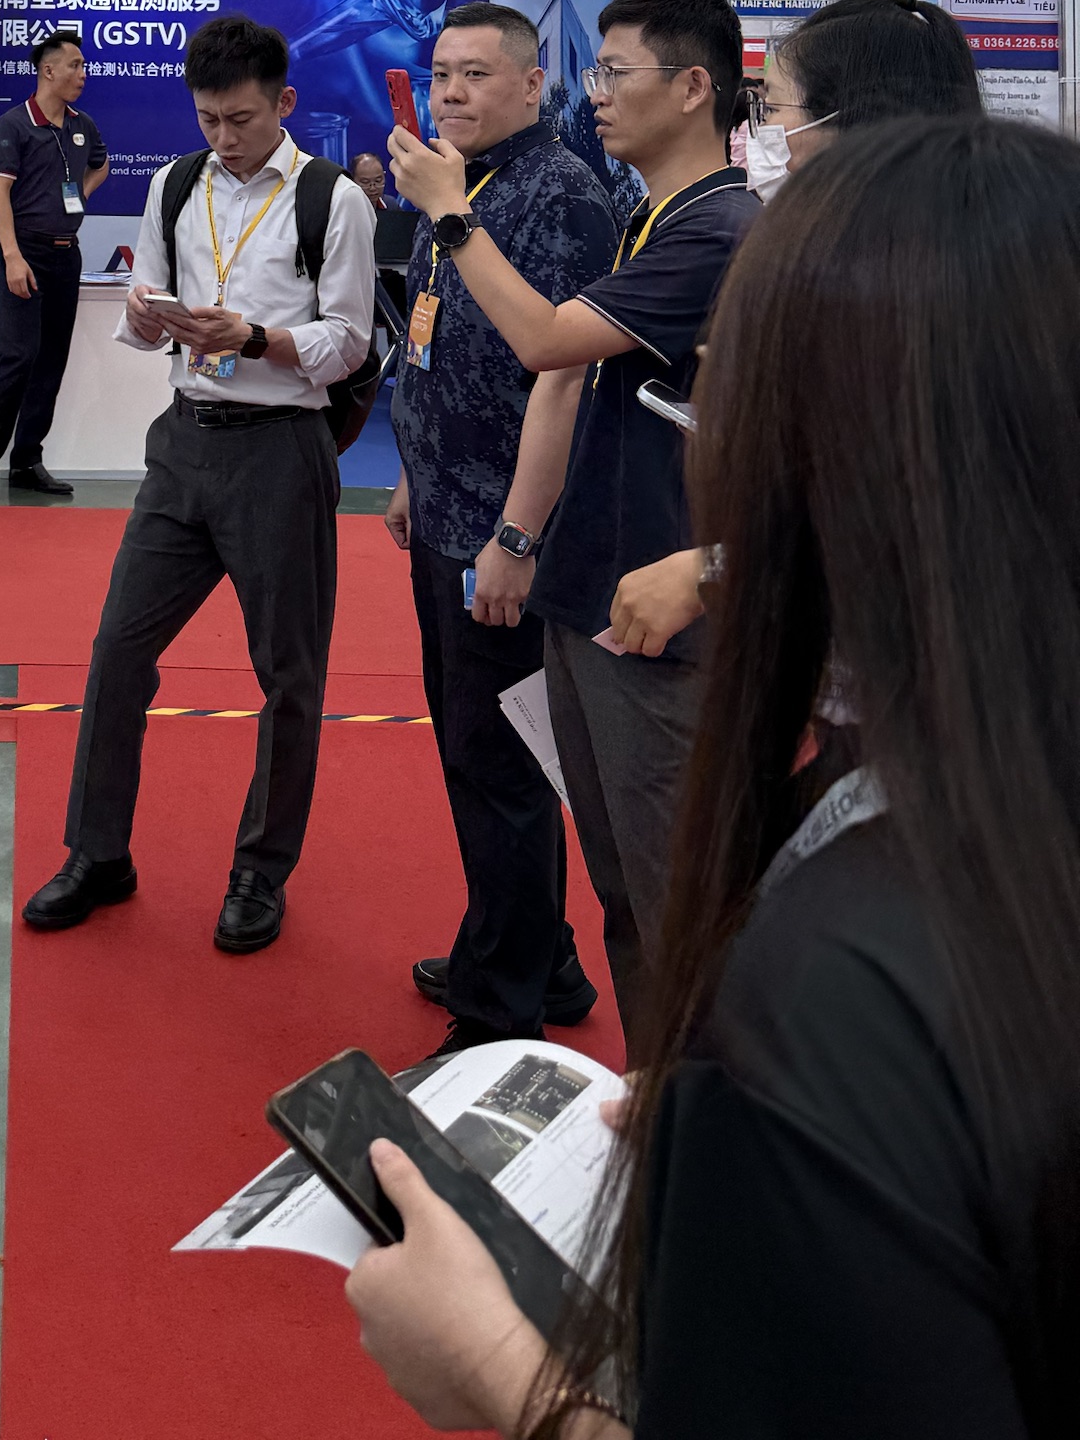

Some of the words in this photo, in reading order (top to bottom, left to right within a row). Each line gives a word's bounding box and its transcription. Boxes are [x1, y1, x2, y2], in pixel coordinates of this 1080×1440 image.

[740, 0, 782, 8] HAIFENG
[784, 0, 832, 8] HARDWA
[93, 21, 187, 50] (GSTV)
[135, 153, 169, 163] Service
[111, 167, 129, 176] and
[131, 166, 158, 176] certif
